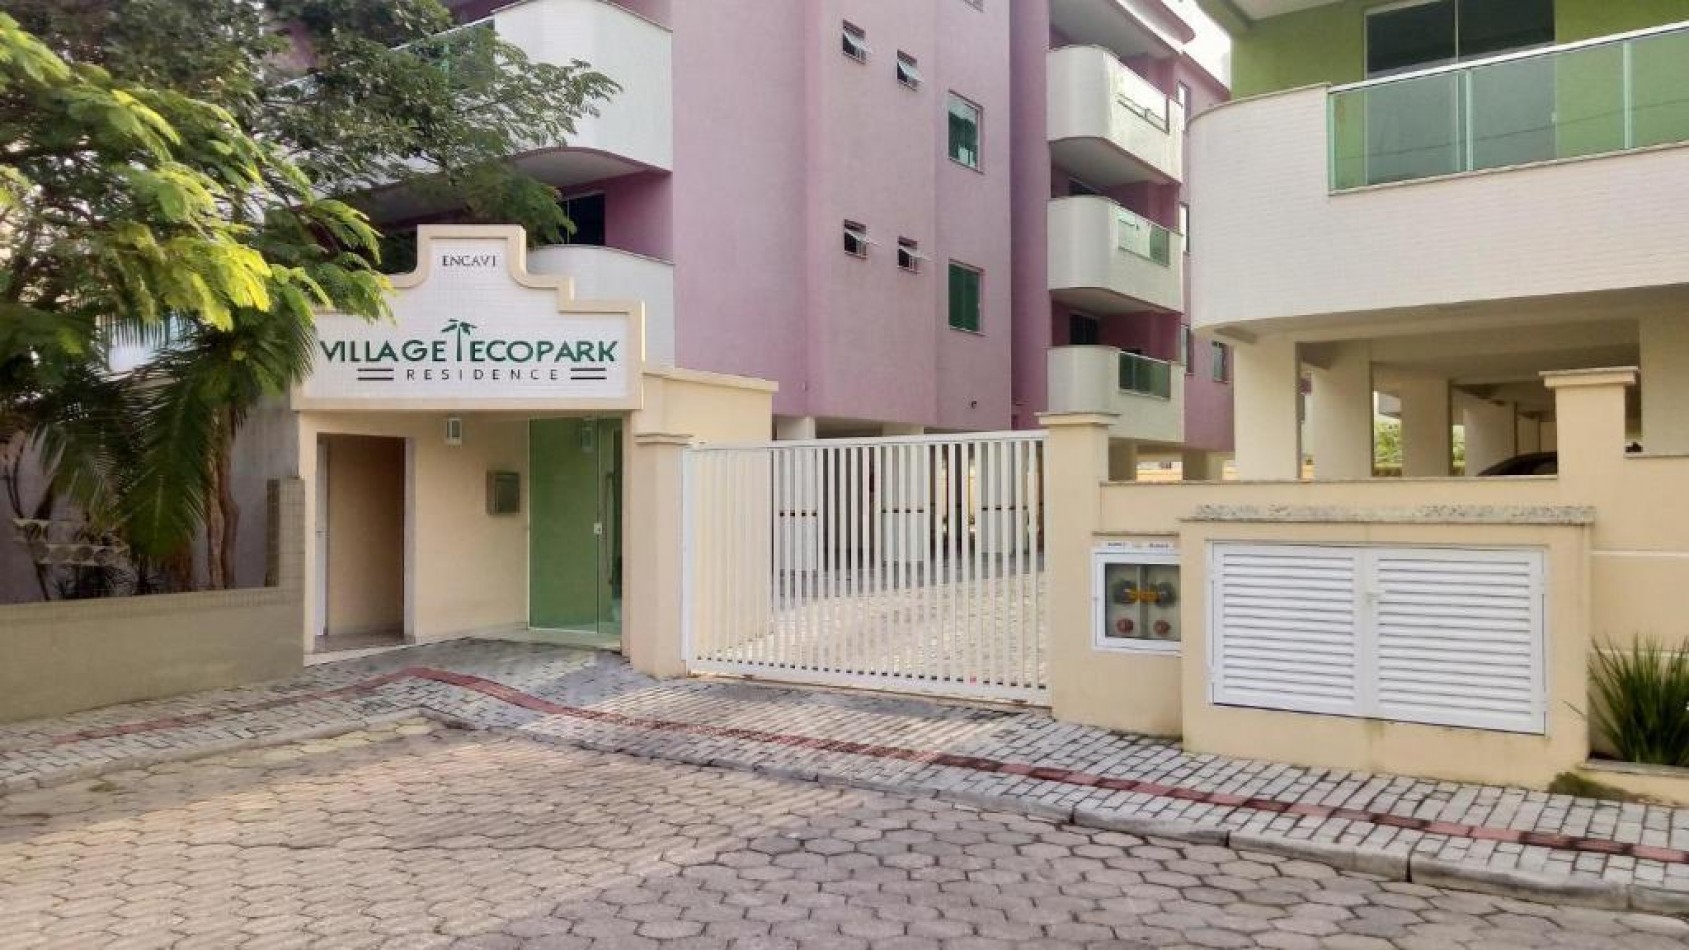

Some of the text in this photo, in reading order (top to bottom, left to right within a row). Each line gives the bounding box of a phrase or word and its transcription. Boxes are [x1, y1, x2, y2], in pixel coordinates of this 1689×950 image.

[442, 255, 496, 267] ENCAVI
[320, 340, 618, 362] VILLAGE ECOPARK
[406, 368, 559, 380] RESIDENCE
